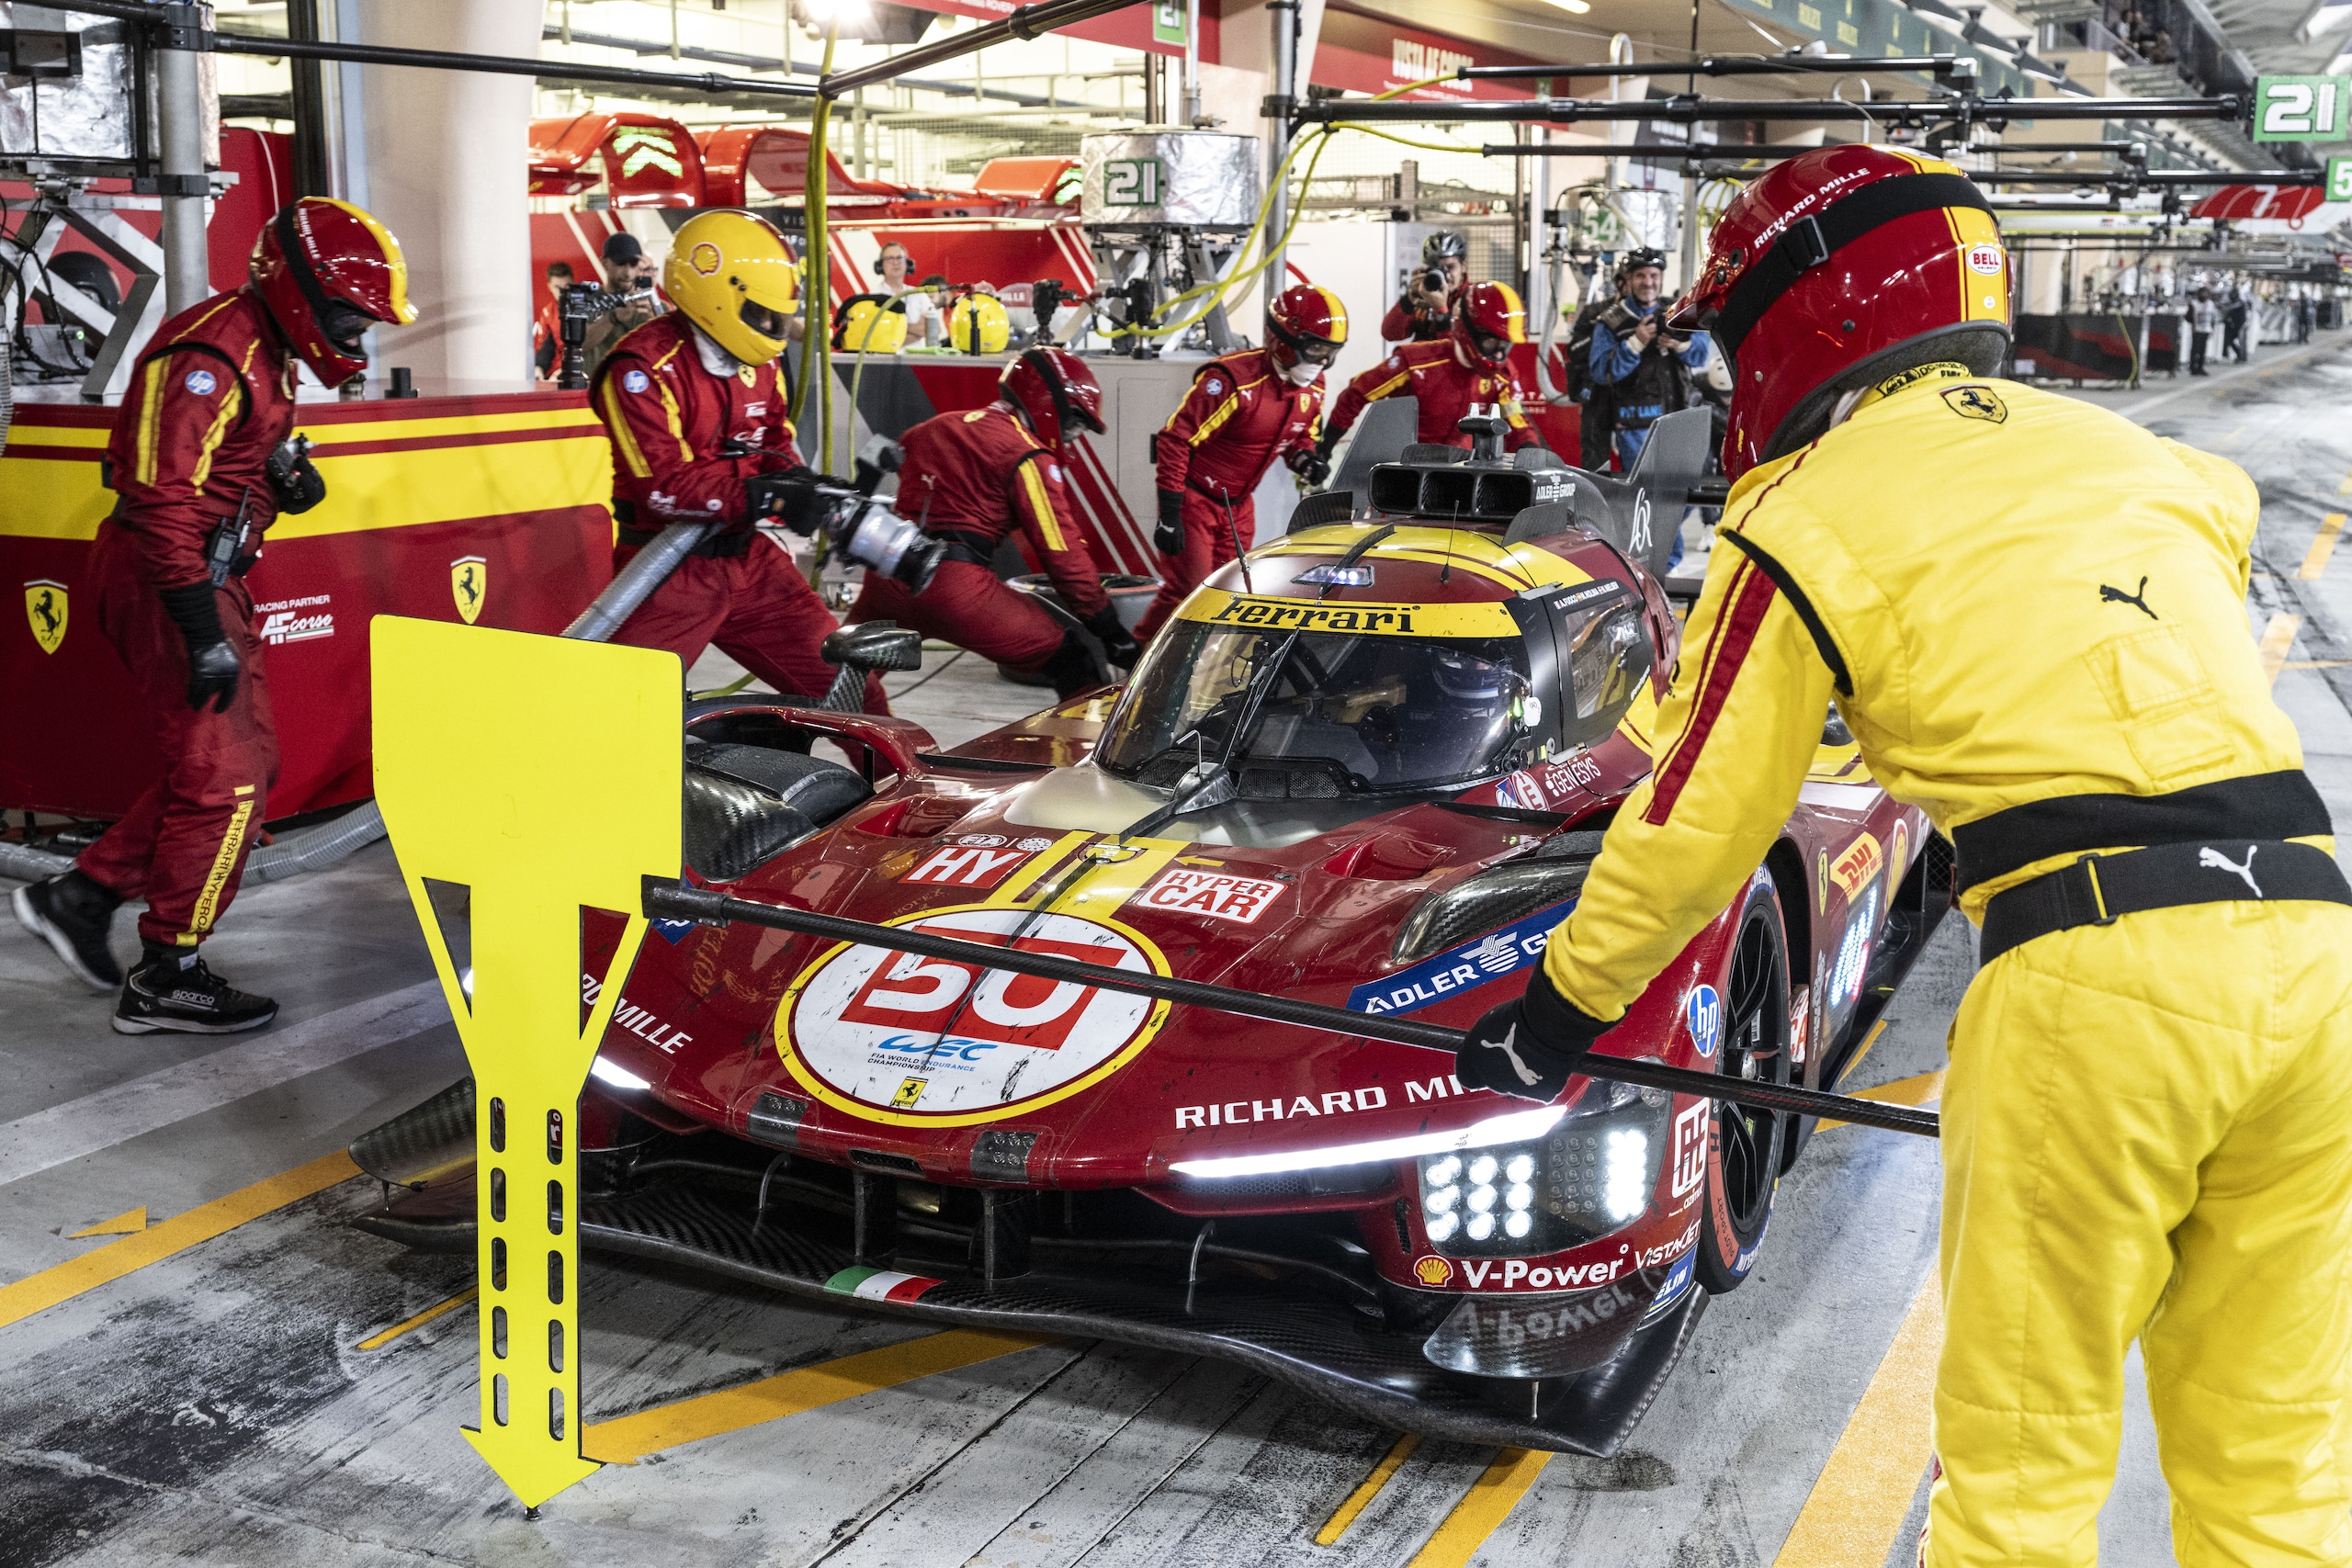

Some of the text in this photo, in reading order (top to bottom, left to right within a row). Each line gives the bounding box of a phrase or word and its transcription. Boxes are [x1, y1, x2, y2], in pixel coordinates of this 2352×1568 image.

[2264, 84, 2336, 132] 21
[1107, 162, 1157, 203] 21
[1754, 167, 1871, 249] RICHARD MILLE
[1973, 253, 1999, 265] BELL
[1536, 482, 1577, 501] ADLER GROUP
[253, 594, 331, 613] RACING PARTNER
[1210, 596, 1415, 633] Ferrari
[289, 614, 333, 631] corse
[1552, 756, 1601, 794] GENESYS
[220, 809, 247, 870] FERRARI
[907, 848, 1025, 885] HY
[1166, 873, 1274, 897] HYPER
[1148, 885, 1261, 919] CAR
[172, 989, 215, 1002] sparco
[863, 946, 1091, 1027] 50
[1365, 964, 1481, 1015] ADLER
[614, 998, 694, 1055] MILLE
[1692, 987, 1718, 1056] hp
[867, 1057, 935, 1073] CHAMPIONSHIP
[877, 1034, 1000, 1062] WEC
[888, 1054, 920, 1065] WORLD
[920, 1059, 976, 1073] ENDURANCE
[1175, 1086, 1388, 1129] RICHARD
[1634, 1218, 1702, 1270] VISTAJET
[1461, 1258, 1624, 1288] V-Power
